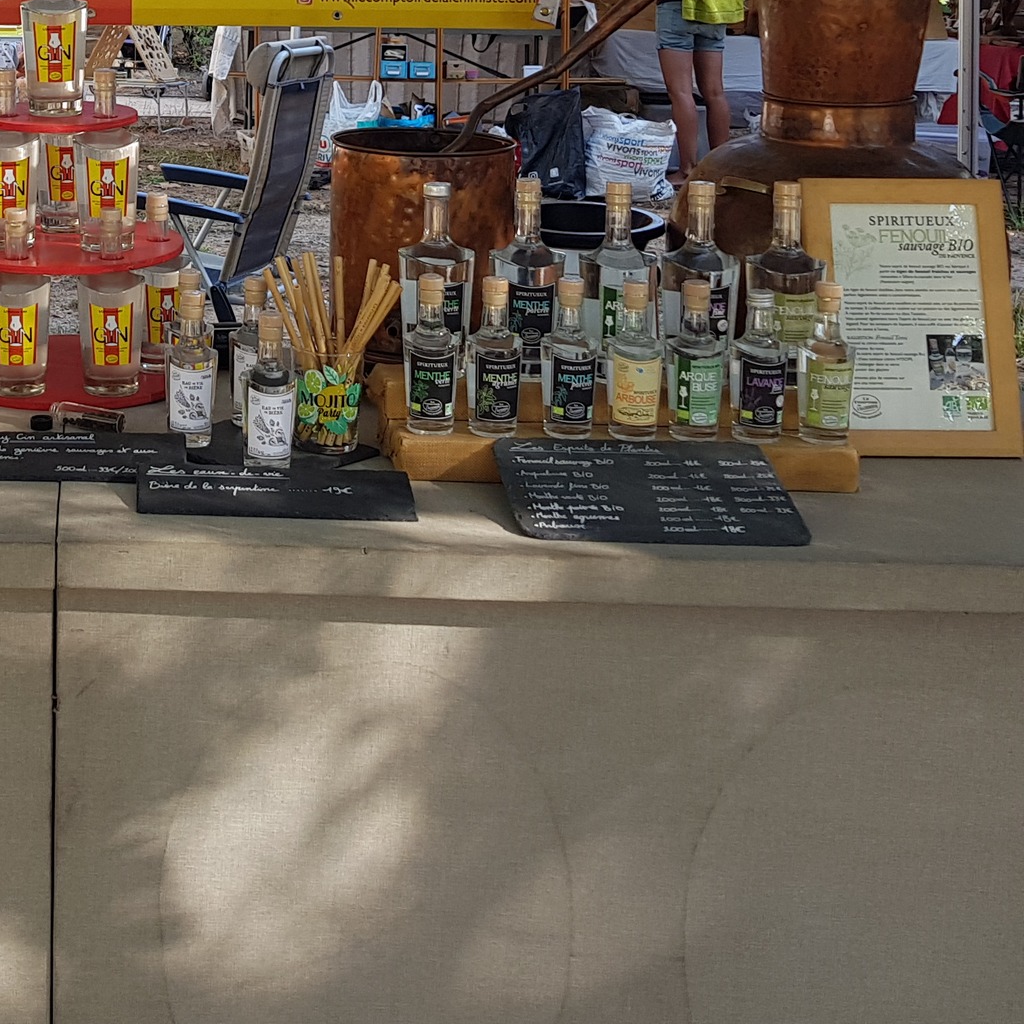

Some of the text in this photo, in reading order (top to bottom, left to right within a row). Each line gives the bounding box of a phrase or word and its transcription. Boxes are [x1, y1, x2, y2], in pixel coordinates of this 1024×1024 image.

[606, 142, 641, 156] vivons
[616, 159, 644, 170] sport
[90, 179, 125, 198] GIN
[868, 215, 955, 227] SPIRITUEUX
[879, 229, 950, 243] FENOUIL
[898, 239, 974, 256] sauvage BIO
[0, 326, 33, 345] GIN
[93, 326, 128, 345] GIN
[414, 370, 451, 380] MENTHE
[680, 371, 717, 382] ARQUE
[692, 382, 718, 392] BUSE
[301, 391, 359, 407] MOJITO
